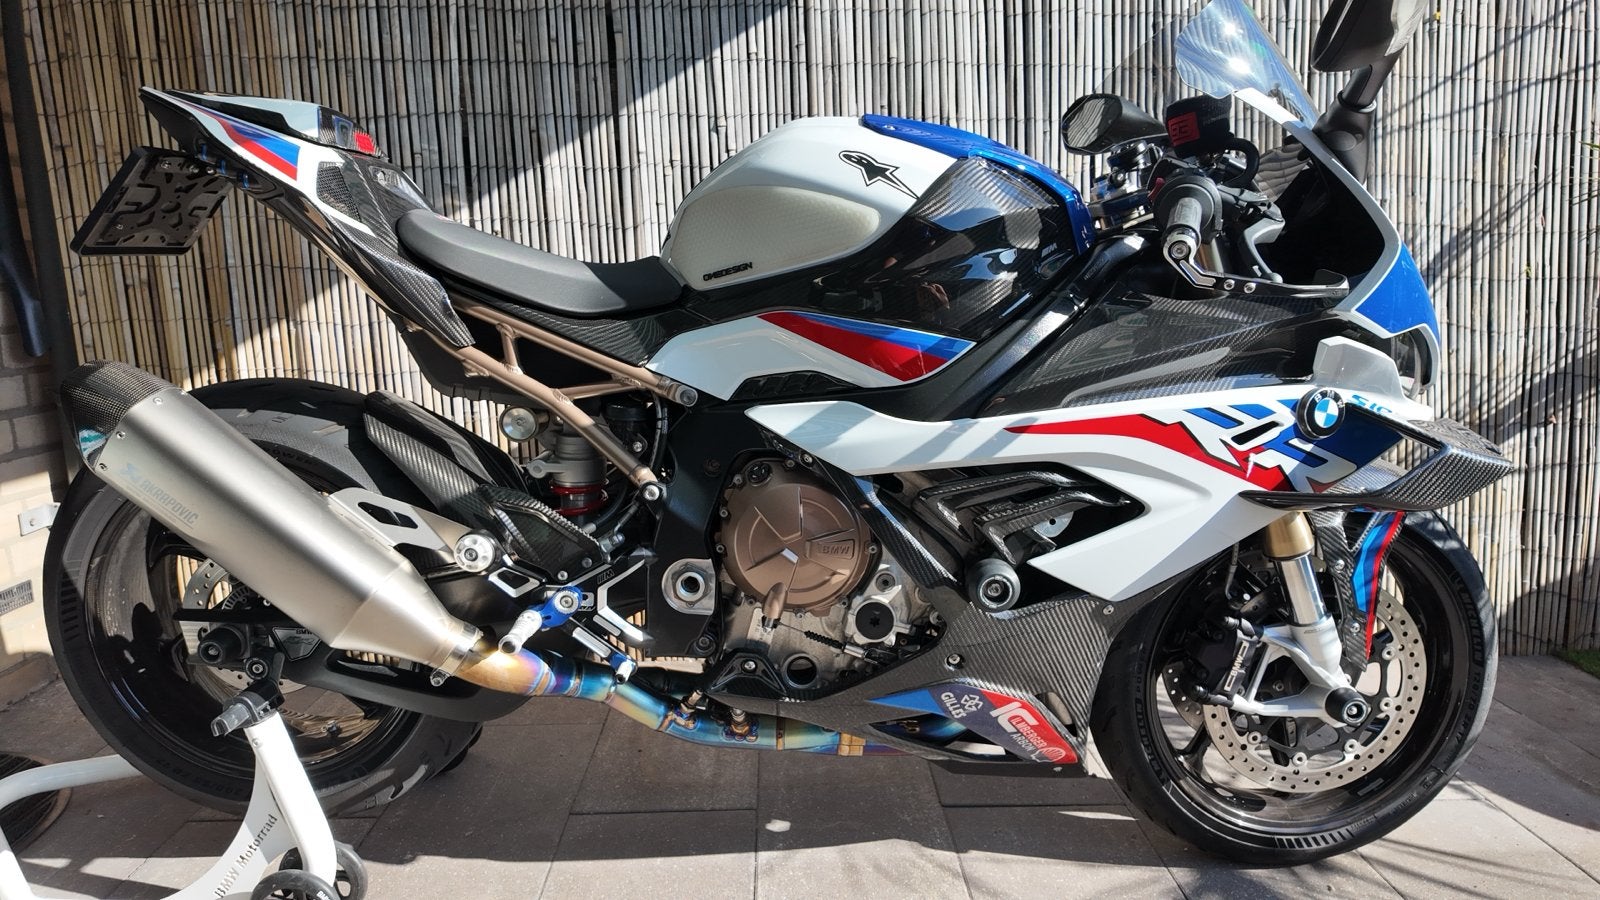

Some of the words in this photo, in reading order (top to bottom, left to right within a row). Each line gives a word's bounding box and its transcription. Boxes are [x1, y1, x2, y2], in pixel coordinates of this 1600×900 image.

[703, 262, 752, 281] ONEDESIGN
[822, 545, 850, 555] BMW
[1460, 590, 1483, 661] MICHELIN
[1230, 654, 1244, 678] BMW
[940, 692, 967, 719] GILLES
[1135, 700, 1161, 772] MICHELIN
[214, 867, 240, 899] BMW
[235, 813, 278, 869] Motorrad
